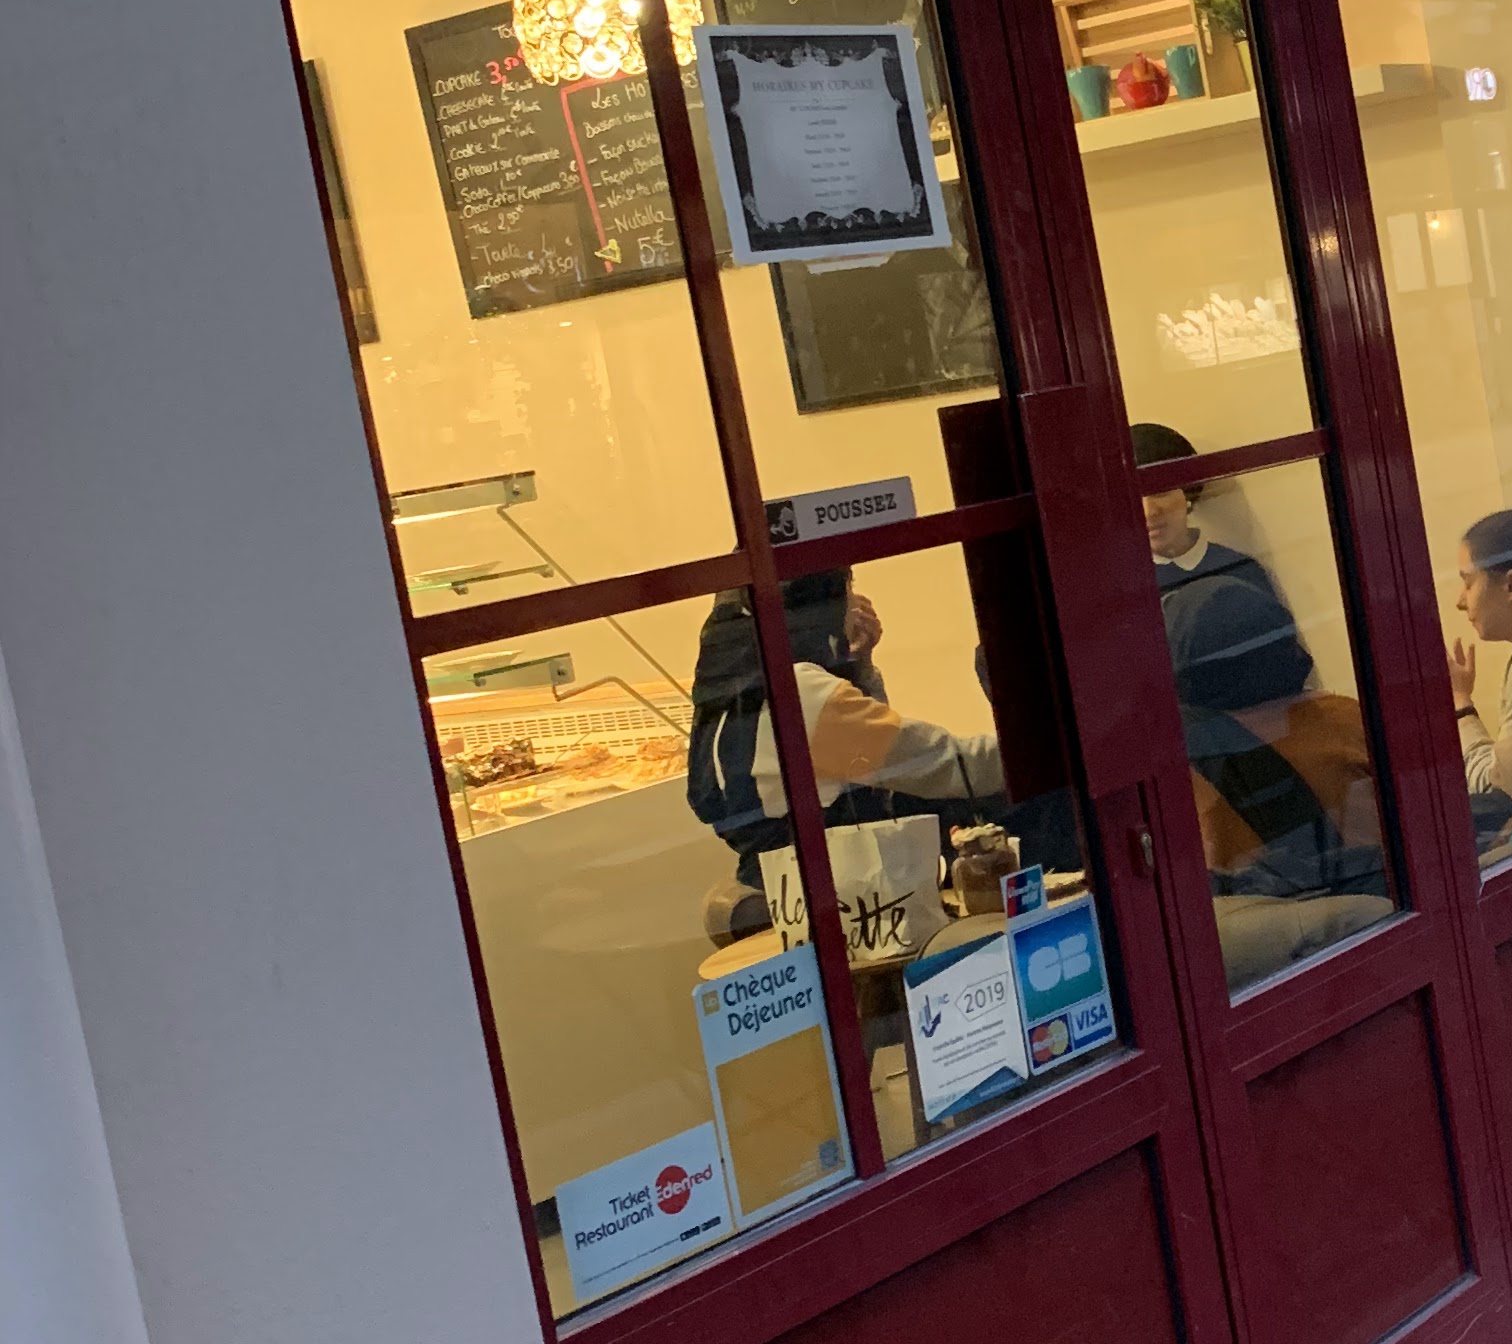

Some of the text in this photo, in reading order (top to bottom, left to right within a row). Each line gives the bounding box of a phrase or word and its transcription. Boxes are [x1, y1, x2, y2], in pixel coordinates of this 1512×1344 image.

[815, 492, 898, 525] POUSSEZ
[723, 965, 798, 1007] Chèque
[963, 981, 1005, 1014] 2019
[727, 986, 814, 1037] Déjeuner
[1076, 1003, 1108, 1032] VISA
[656, 1164, 713, 1201] Edenred
[609, 1185, 651, 1216] Ticket
[575, 1203, 655, 1251] Restaurant
